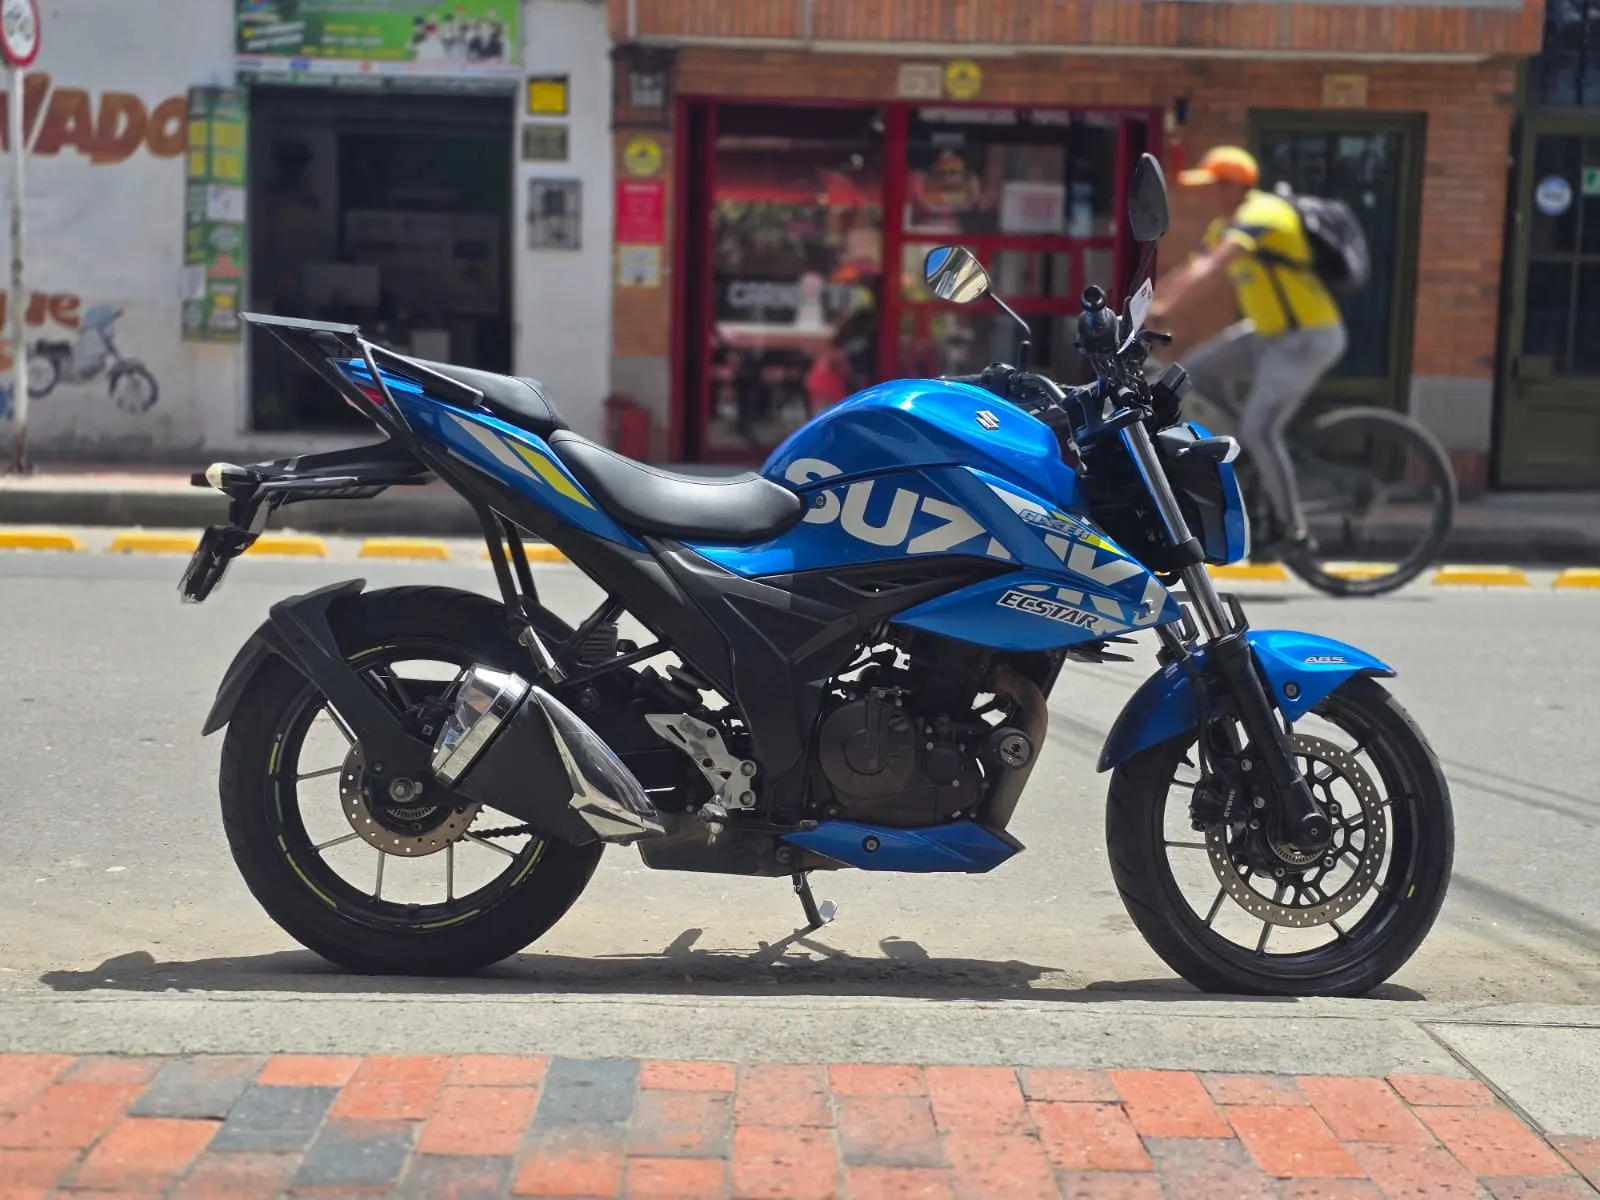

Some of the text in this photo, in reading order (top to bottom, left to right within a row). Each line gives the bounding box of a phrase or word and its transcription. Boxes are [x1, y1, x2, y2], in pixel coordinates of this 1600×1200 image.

[0, 72, 188, 165] VADO
[997, 590, 1099, 629] ECSTAR
[1304, 655, 1345, 665] ABS
